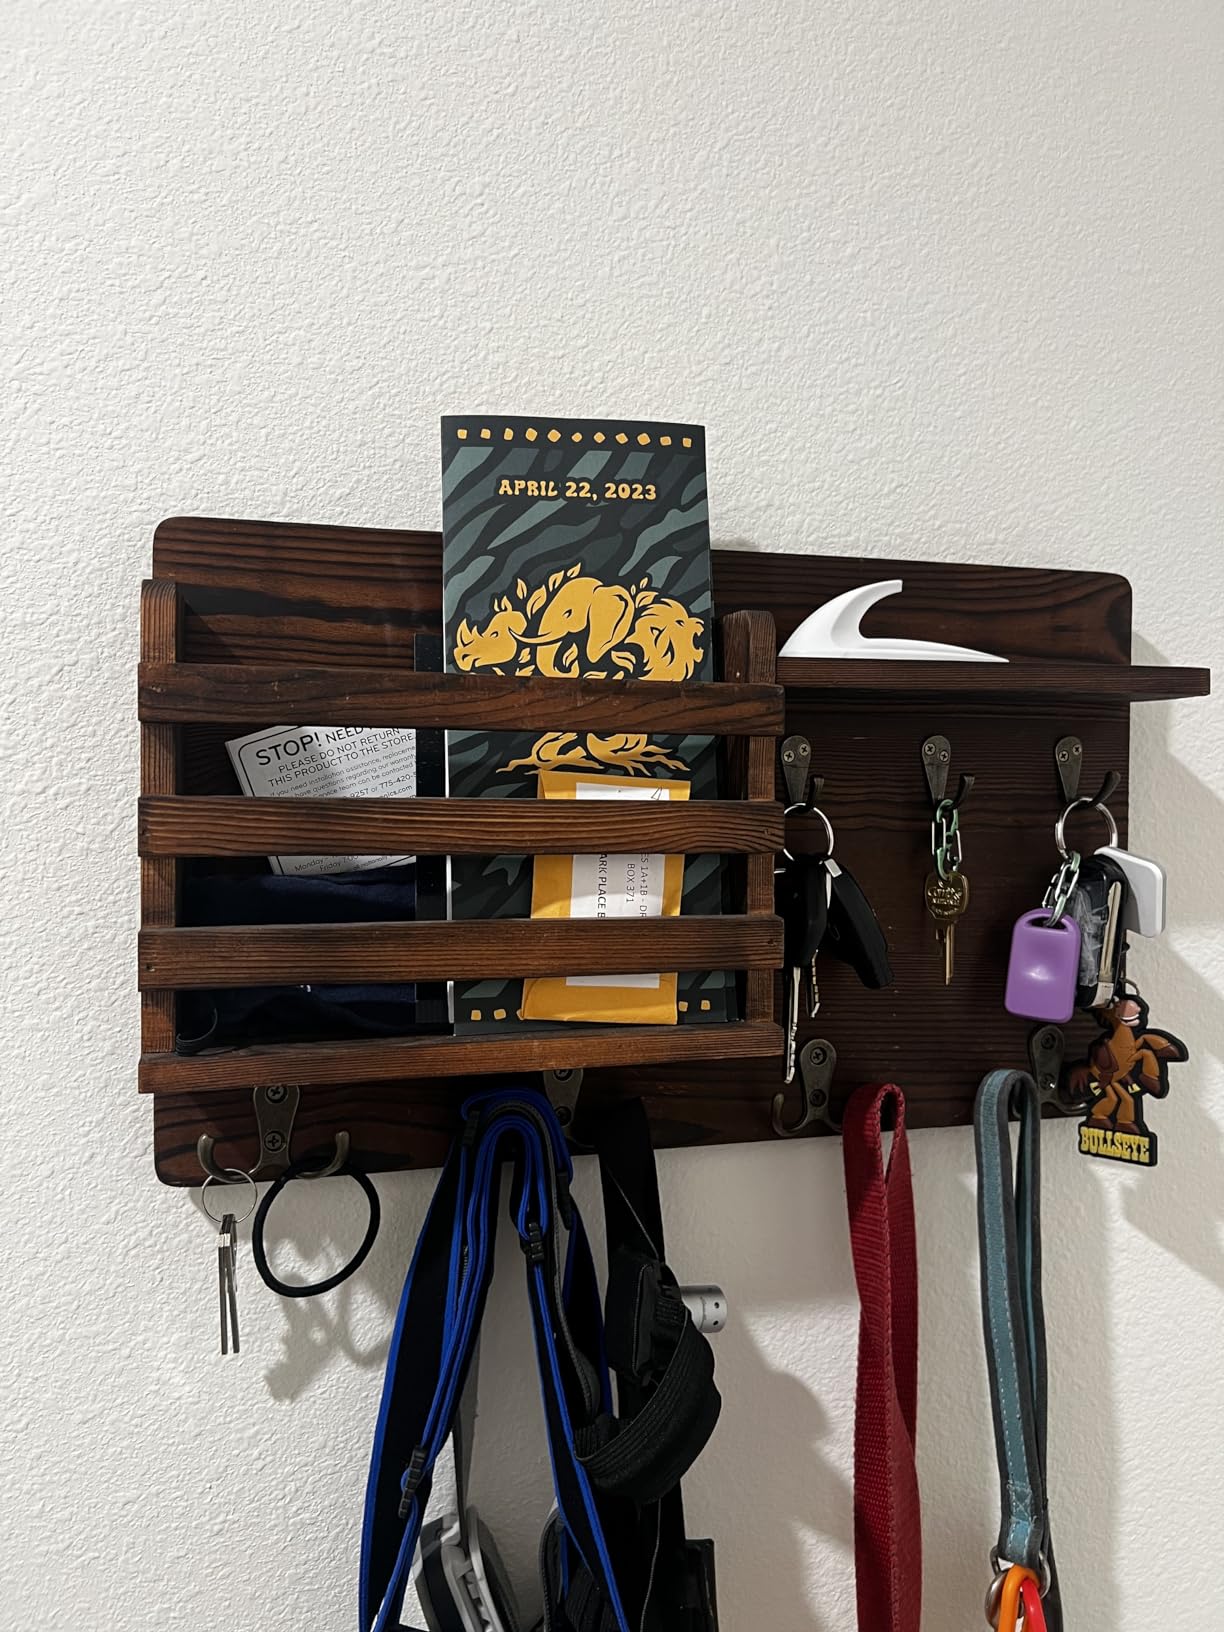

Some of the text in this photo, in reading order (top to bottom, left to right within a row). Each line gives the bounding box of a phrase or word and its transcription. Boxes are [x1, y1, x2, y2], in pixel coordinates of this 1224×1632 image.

[498, 479, 657, 501] APRIL 22, 2023
[255, 727, 364, 766] STOP! NEED
[278, 728, 400, 774] PLEASE DO NOT RETURN
[268, 774, 293, 787] THIS
[294, 756, 343, 779] PRODUCT
[344, 751, 359, 761] TO
[359, 744, 380, 756] THE
[291, 782, 307, 792] need
[309, 769, 345, 785] installation
[345, 758, 382, 773] assistance,
[382, 745, 416, 760] replaceme
[312, 779, 344, 794] questions
[346, 767, 377, 782] regarding
[339, 782, 357, 791] team
[358, 777, 371, 785] can
[382, 762, 413, 777] contacted
[294, 858, 324, 872] Monday
[320, 861, 341, 872] Friday
[598, 853, 608, 874] ARK
[597, 876, 607, 909] PLACE
[626, 863, 636, 903] BOX 371
[639, 867, 649, 896] 1A+1B
[1080, 1126, 1150, 1163] BULLSEYE
